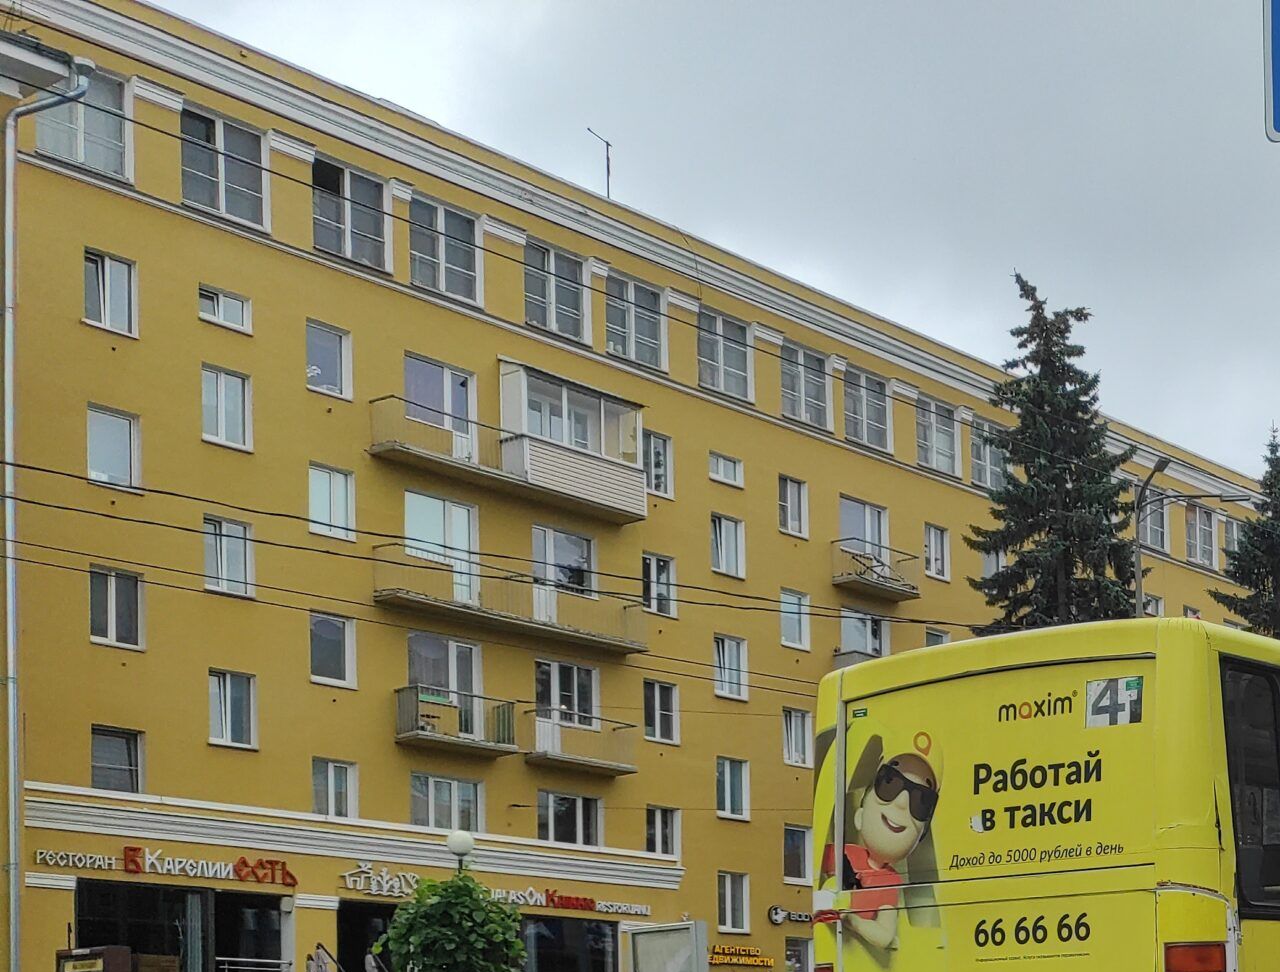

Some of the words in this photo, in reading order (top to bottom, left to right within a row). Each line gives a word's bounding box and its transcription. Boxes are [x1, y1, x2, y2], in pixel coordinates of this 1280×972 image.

[973, 749, 1102, 796] Работай
[980, 808, 996, 832] в
[1003, 798, 1092, 829] такси
[36, 848, 116, 870] РЕСТОРАН
[948, 854, 986, 871] Доход
[988, 853, 1003, 865] до
[1005, 847, 1037, 863] 5000
[1039, 843, 1083, 863] рублей
[1085, 847, 1092, 856] в
[1095, 841, 1124, 856] день
[974, 919, 1006, 947] 66
[1014, 915, 1048, 945] 66
[1056, 912, 1090, 942] 66
[709, 955, 775, 967] ЕДВИЖИМОСТИ
[714, 945, 761, 955] АГЕНТСТВО
